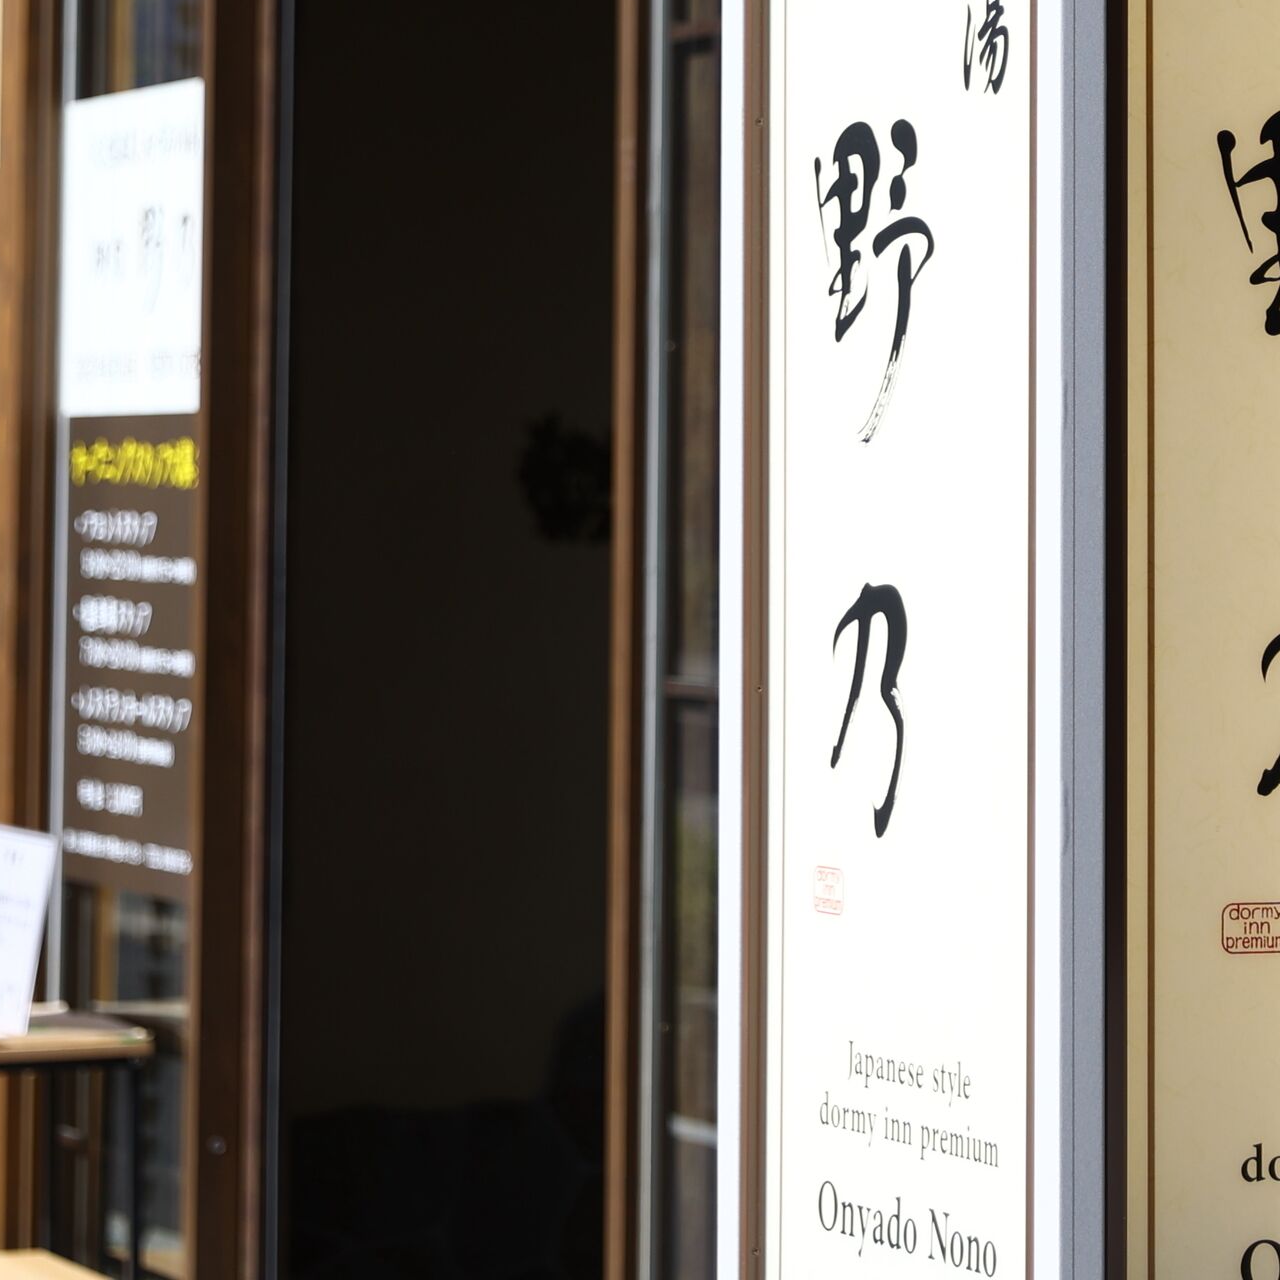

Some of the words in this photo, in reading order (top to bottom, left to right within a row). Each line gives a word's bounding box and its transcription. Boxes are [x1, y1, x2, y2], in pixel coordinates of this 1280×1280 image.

[1244, 921, 1270, 935] inn
[847, 1040, 924, 1092] Japanese
[932, 1061, 971, 1108] style
[819, 1091, 877, 1148] dormy
[884, 1106, 912, 1146] inn
[919, 1123, 999, 1168] premium
[817, 1180, 918, 1258] Onyado
[928, 1208, 997, 1278] Nono
